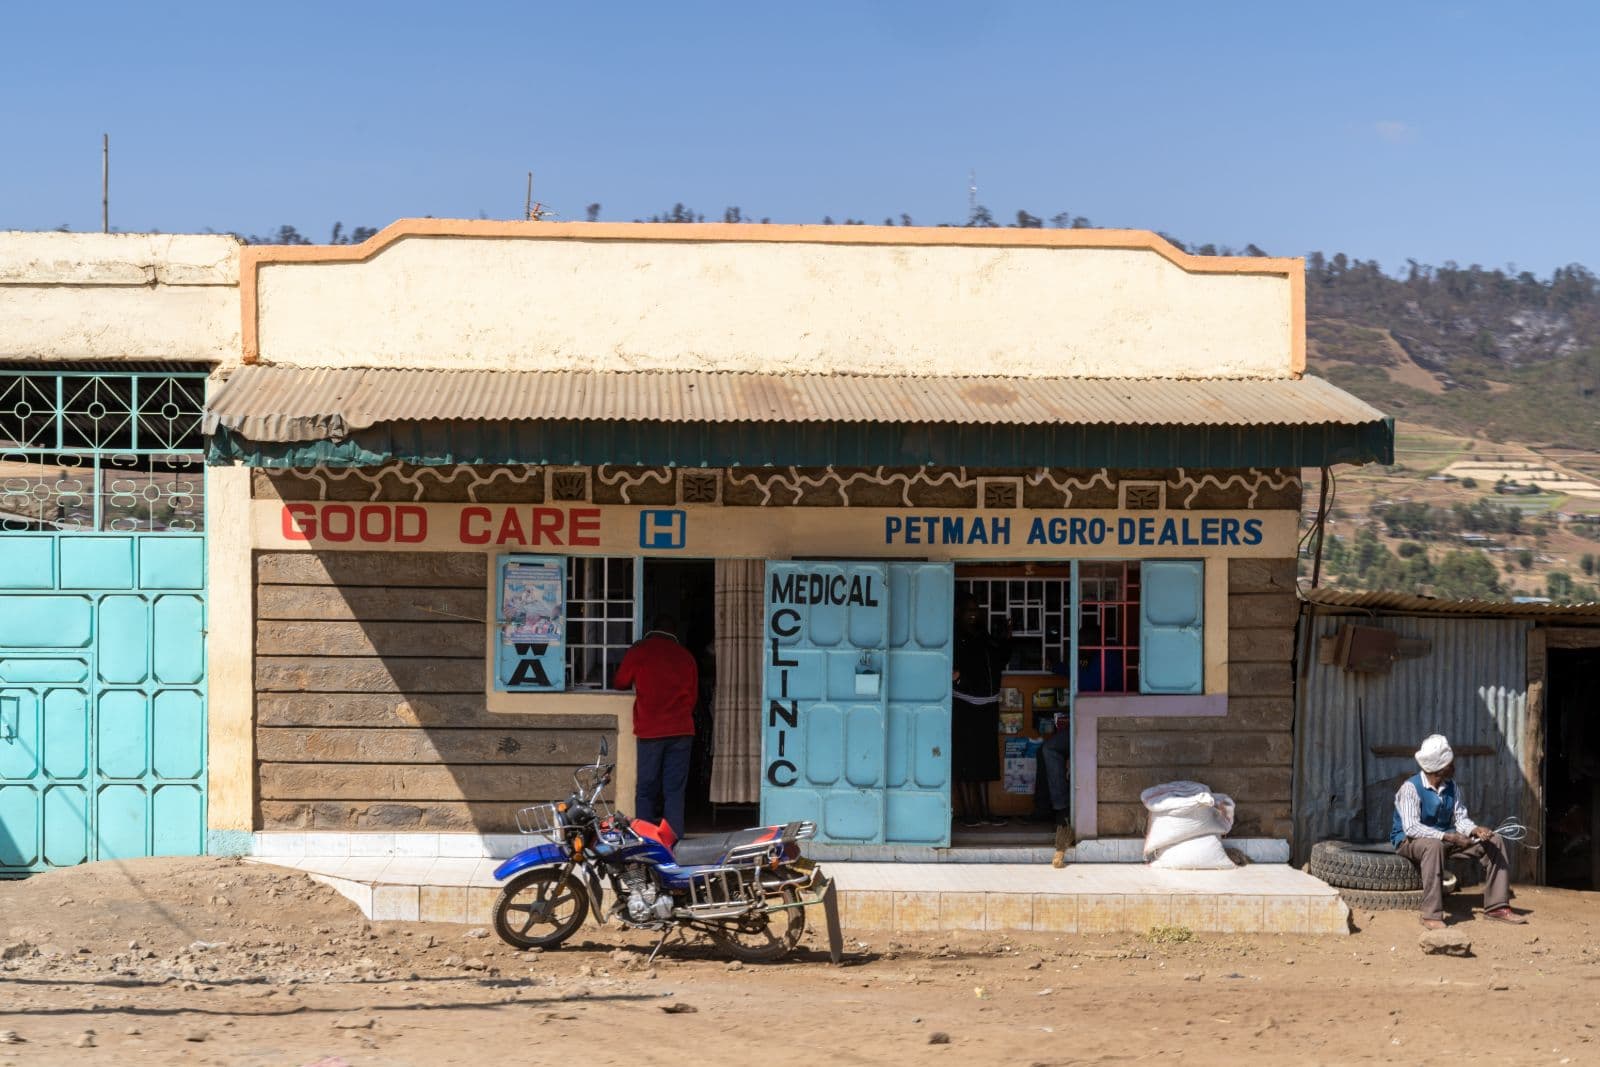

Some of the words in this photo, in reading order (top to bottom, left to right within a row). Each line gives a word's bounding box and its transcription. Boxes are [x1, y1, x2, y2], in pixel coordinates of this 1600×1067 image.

[281, 503, 428, 543] GOOD
[459, 507, 600, 546] CARE
[644, 512, 683, 547] H
[886, 516, 1010, 545] PETMAH
[1027, 517, 1264, 546] AGRO-DEALERS
[771, 573, 878, 607] MEDICAL
[767, 608, 802, 788] CLINIC
